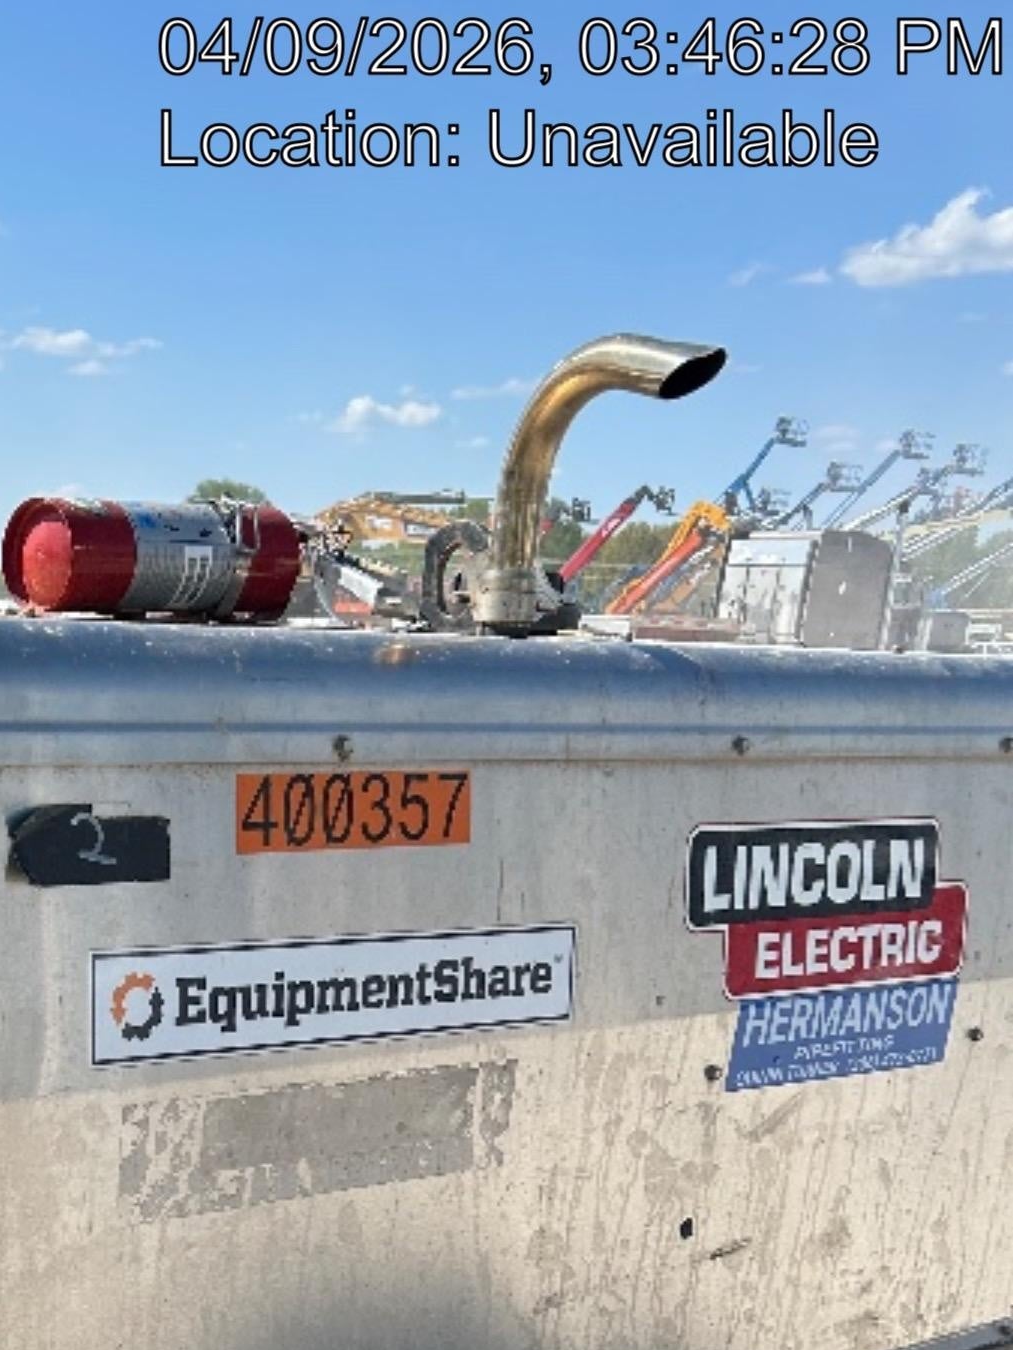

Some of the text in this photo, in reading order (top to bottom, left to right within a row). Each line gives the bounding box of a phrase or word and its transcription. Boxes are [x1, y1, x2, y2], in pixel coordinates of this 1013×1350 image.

[70, 812, 116, 865] 2
[241, 773, 469, 846] 400357
[703, 838, 925, 913] LINCOLN
[755, 919, 942, 979] ELECTRIC
[175, 957, 553, 1033] EquipmentShare
[743, 983, 951, 1048] HERMANSON
